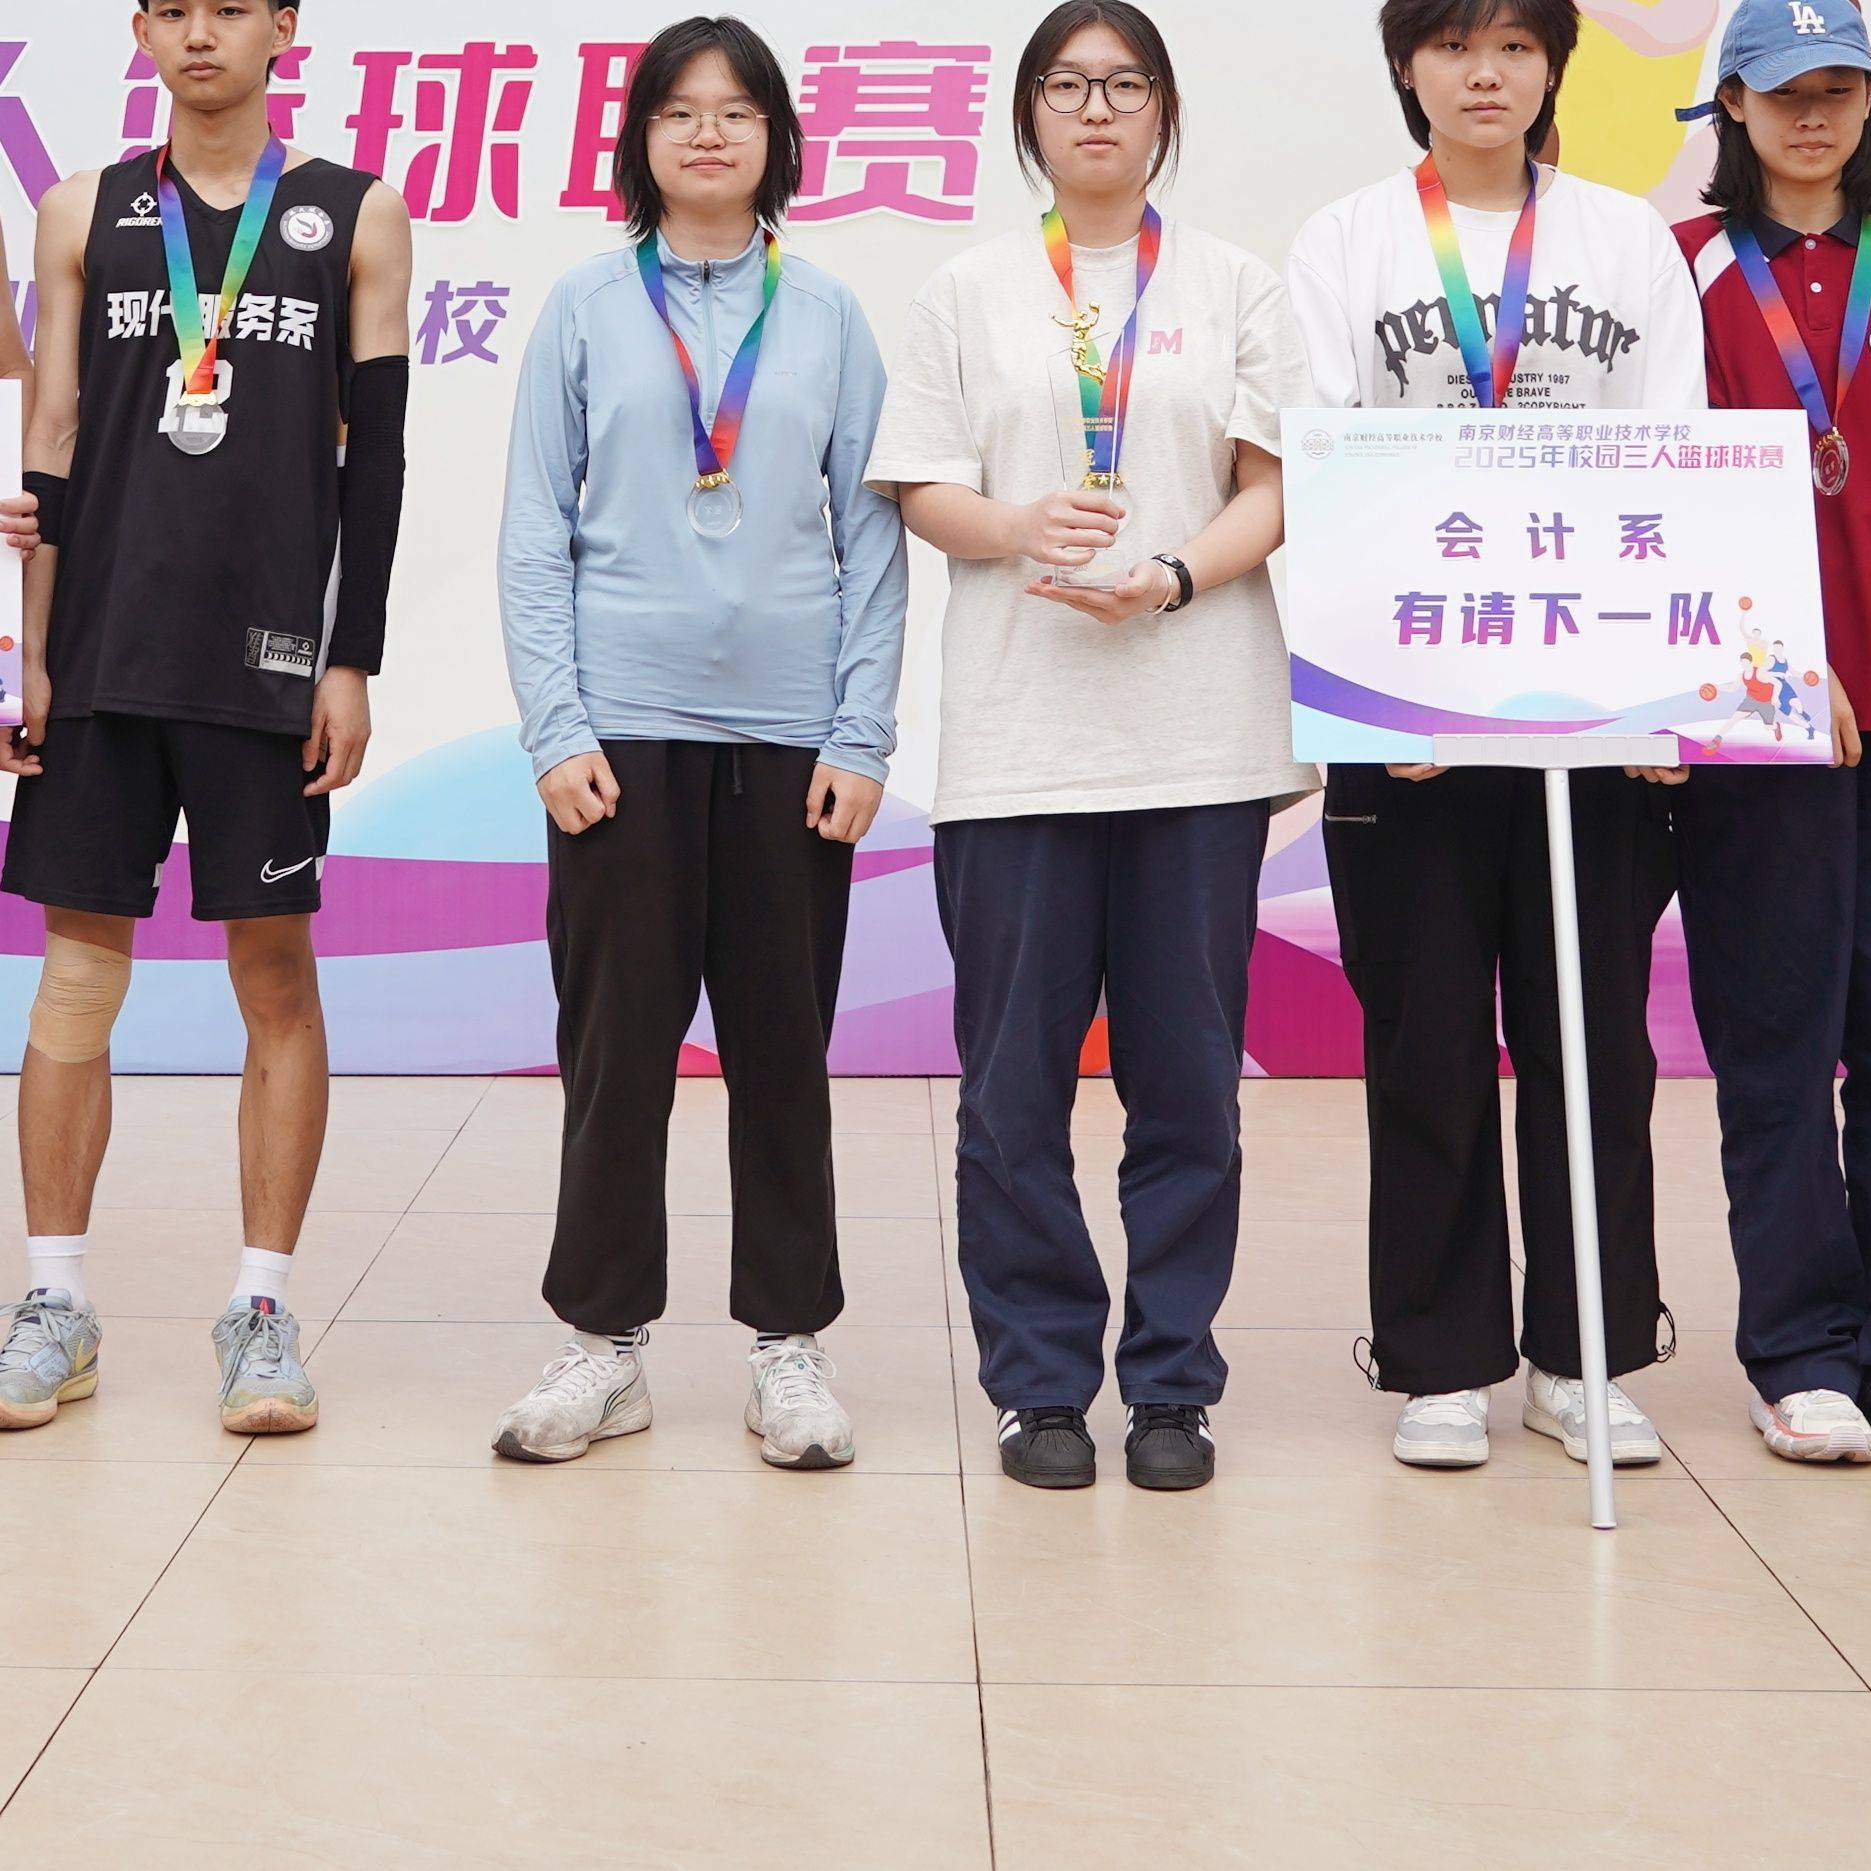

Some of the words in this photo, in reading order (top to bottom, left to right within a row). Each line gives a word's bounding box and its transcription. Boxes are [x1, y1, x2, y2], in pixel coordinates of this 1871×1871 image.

[1788, 1, 1826, 35] LA
[1516, 387, 1551, 398] BRAVE
[1457, 423, 1692, 443] 南京财经高等职业技术学校
[1454, 443, 1786, 471] 2025年校园三人篮球联赛
[1434, 510, 1668, 561] 会计系
[1391, 590, 1722, 647] 有请下一队
